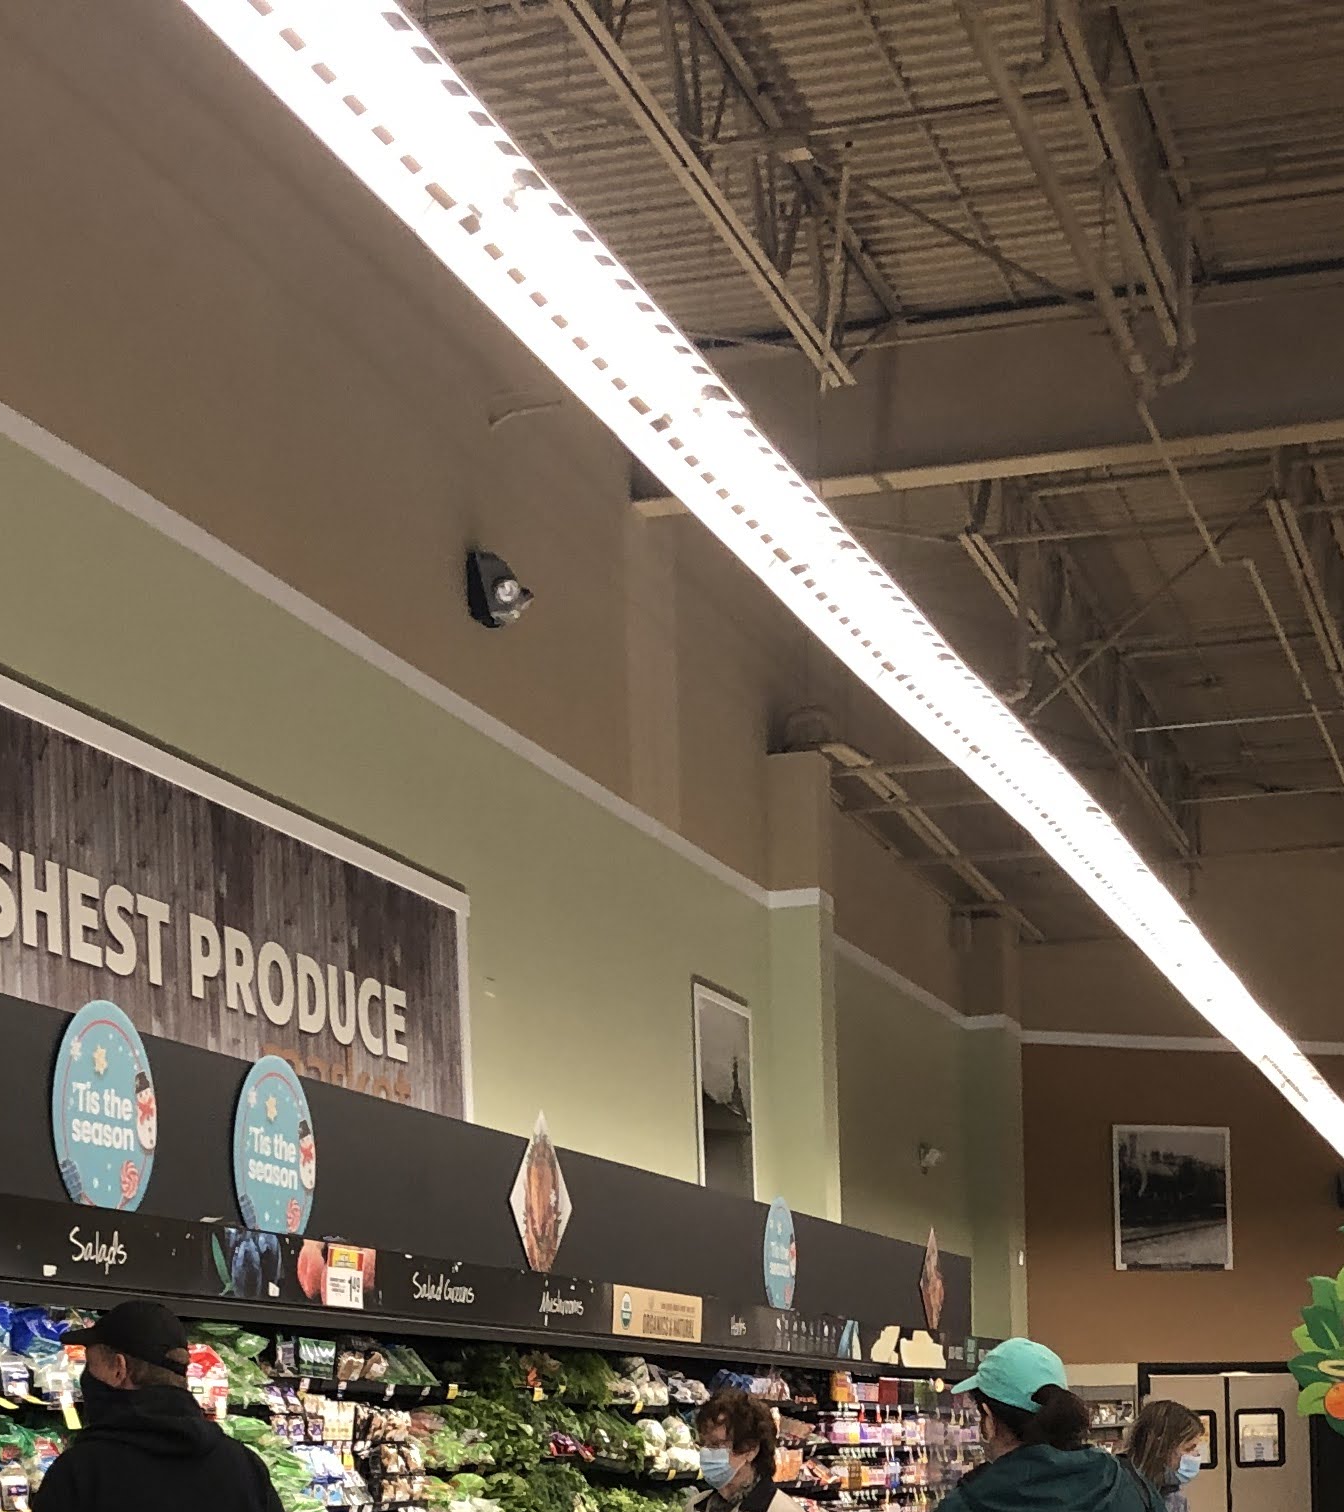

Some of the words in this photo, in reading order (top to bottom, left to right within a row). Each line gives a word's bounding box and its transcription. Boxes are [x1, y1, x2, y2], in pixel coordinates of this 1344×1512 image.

[190, 915, 409, 1063] PRODUCE
[102, 1088, 133, 1121] the
[72, 1118, 135, 1152] season
[273, 1132, 296, 1163] the
[249, 1158, 298, 1191] season
[69, 1226, 128, 1266] Salads
